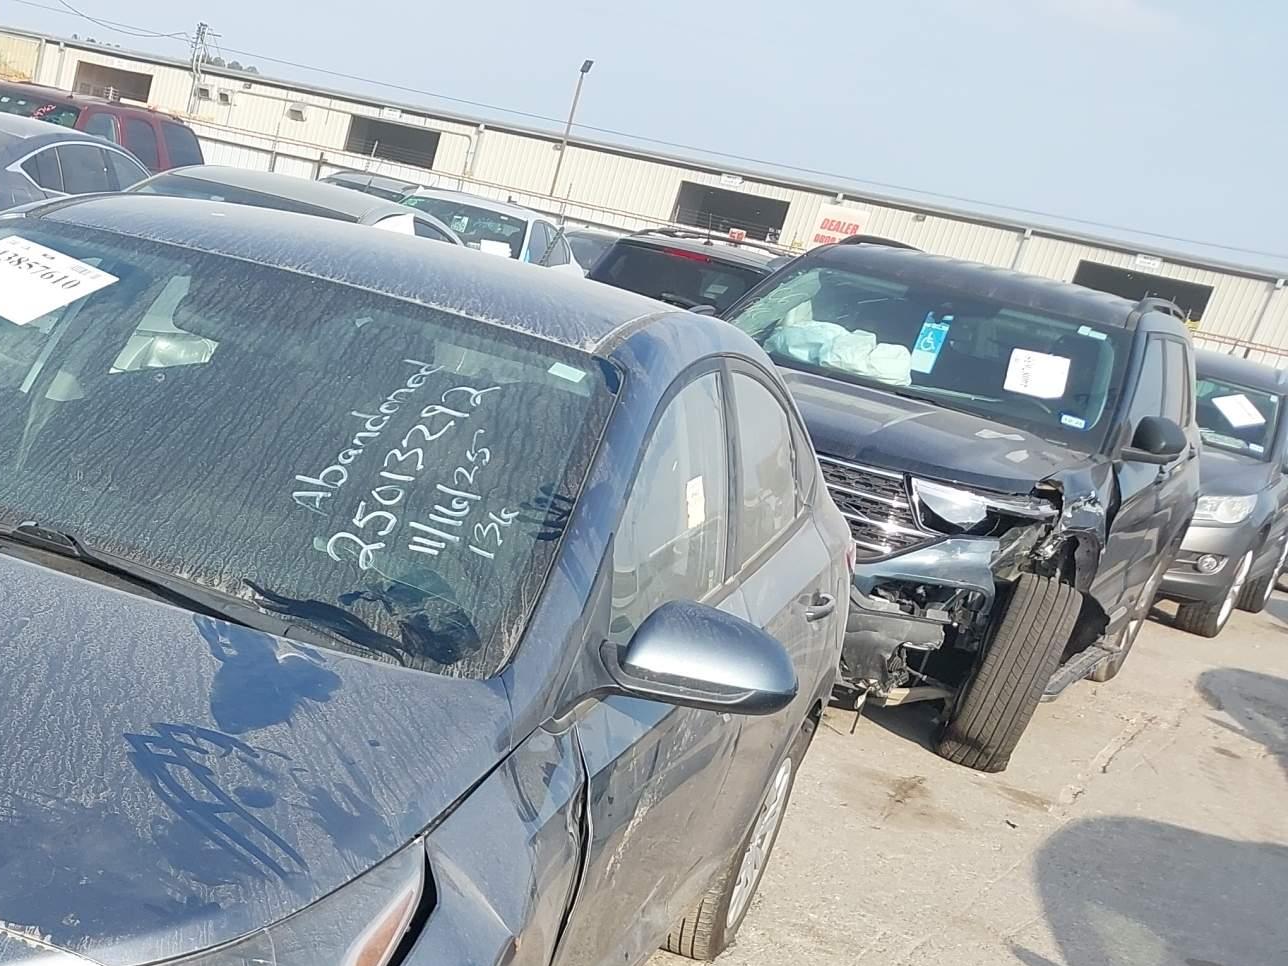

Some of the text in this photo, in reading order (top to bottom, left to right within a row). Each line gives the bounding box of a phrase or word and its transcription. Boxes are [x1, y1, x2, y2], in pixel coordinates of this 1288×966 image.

[819, 218, 860, 235] DEALER
[326, 385, 502, 570] 25013292
[408, 428, 491, 556] 11/16/25
